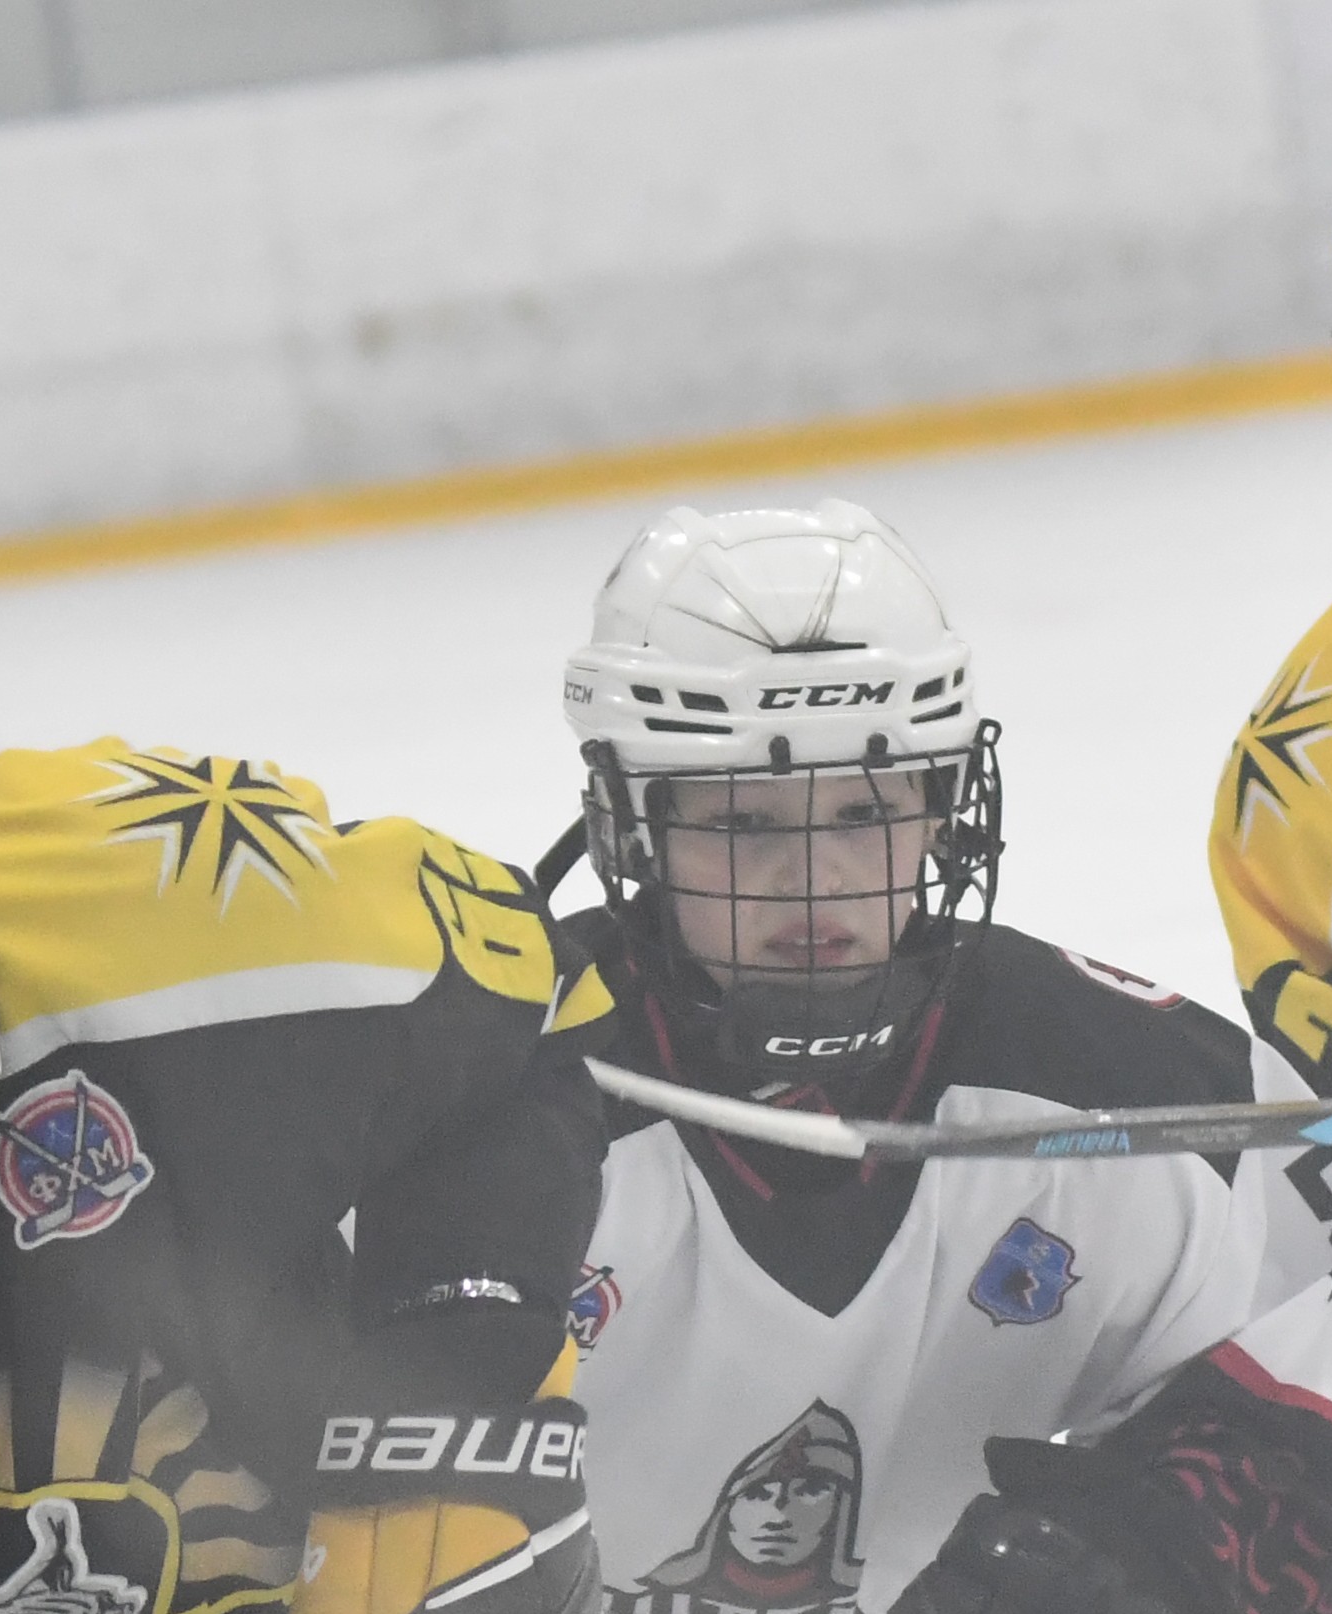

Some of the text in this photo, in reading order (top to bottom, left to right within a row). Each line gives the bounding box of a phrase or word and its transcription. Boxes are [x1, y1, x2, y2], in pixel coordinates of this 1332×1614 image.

[757, 681, 895, 711] CCM
[766, 1022, 894, 1057] CCM
[30, 1138, 120, 1203] ФХМ
[316, 1416, 587, 1480] BAUER
